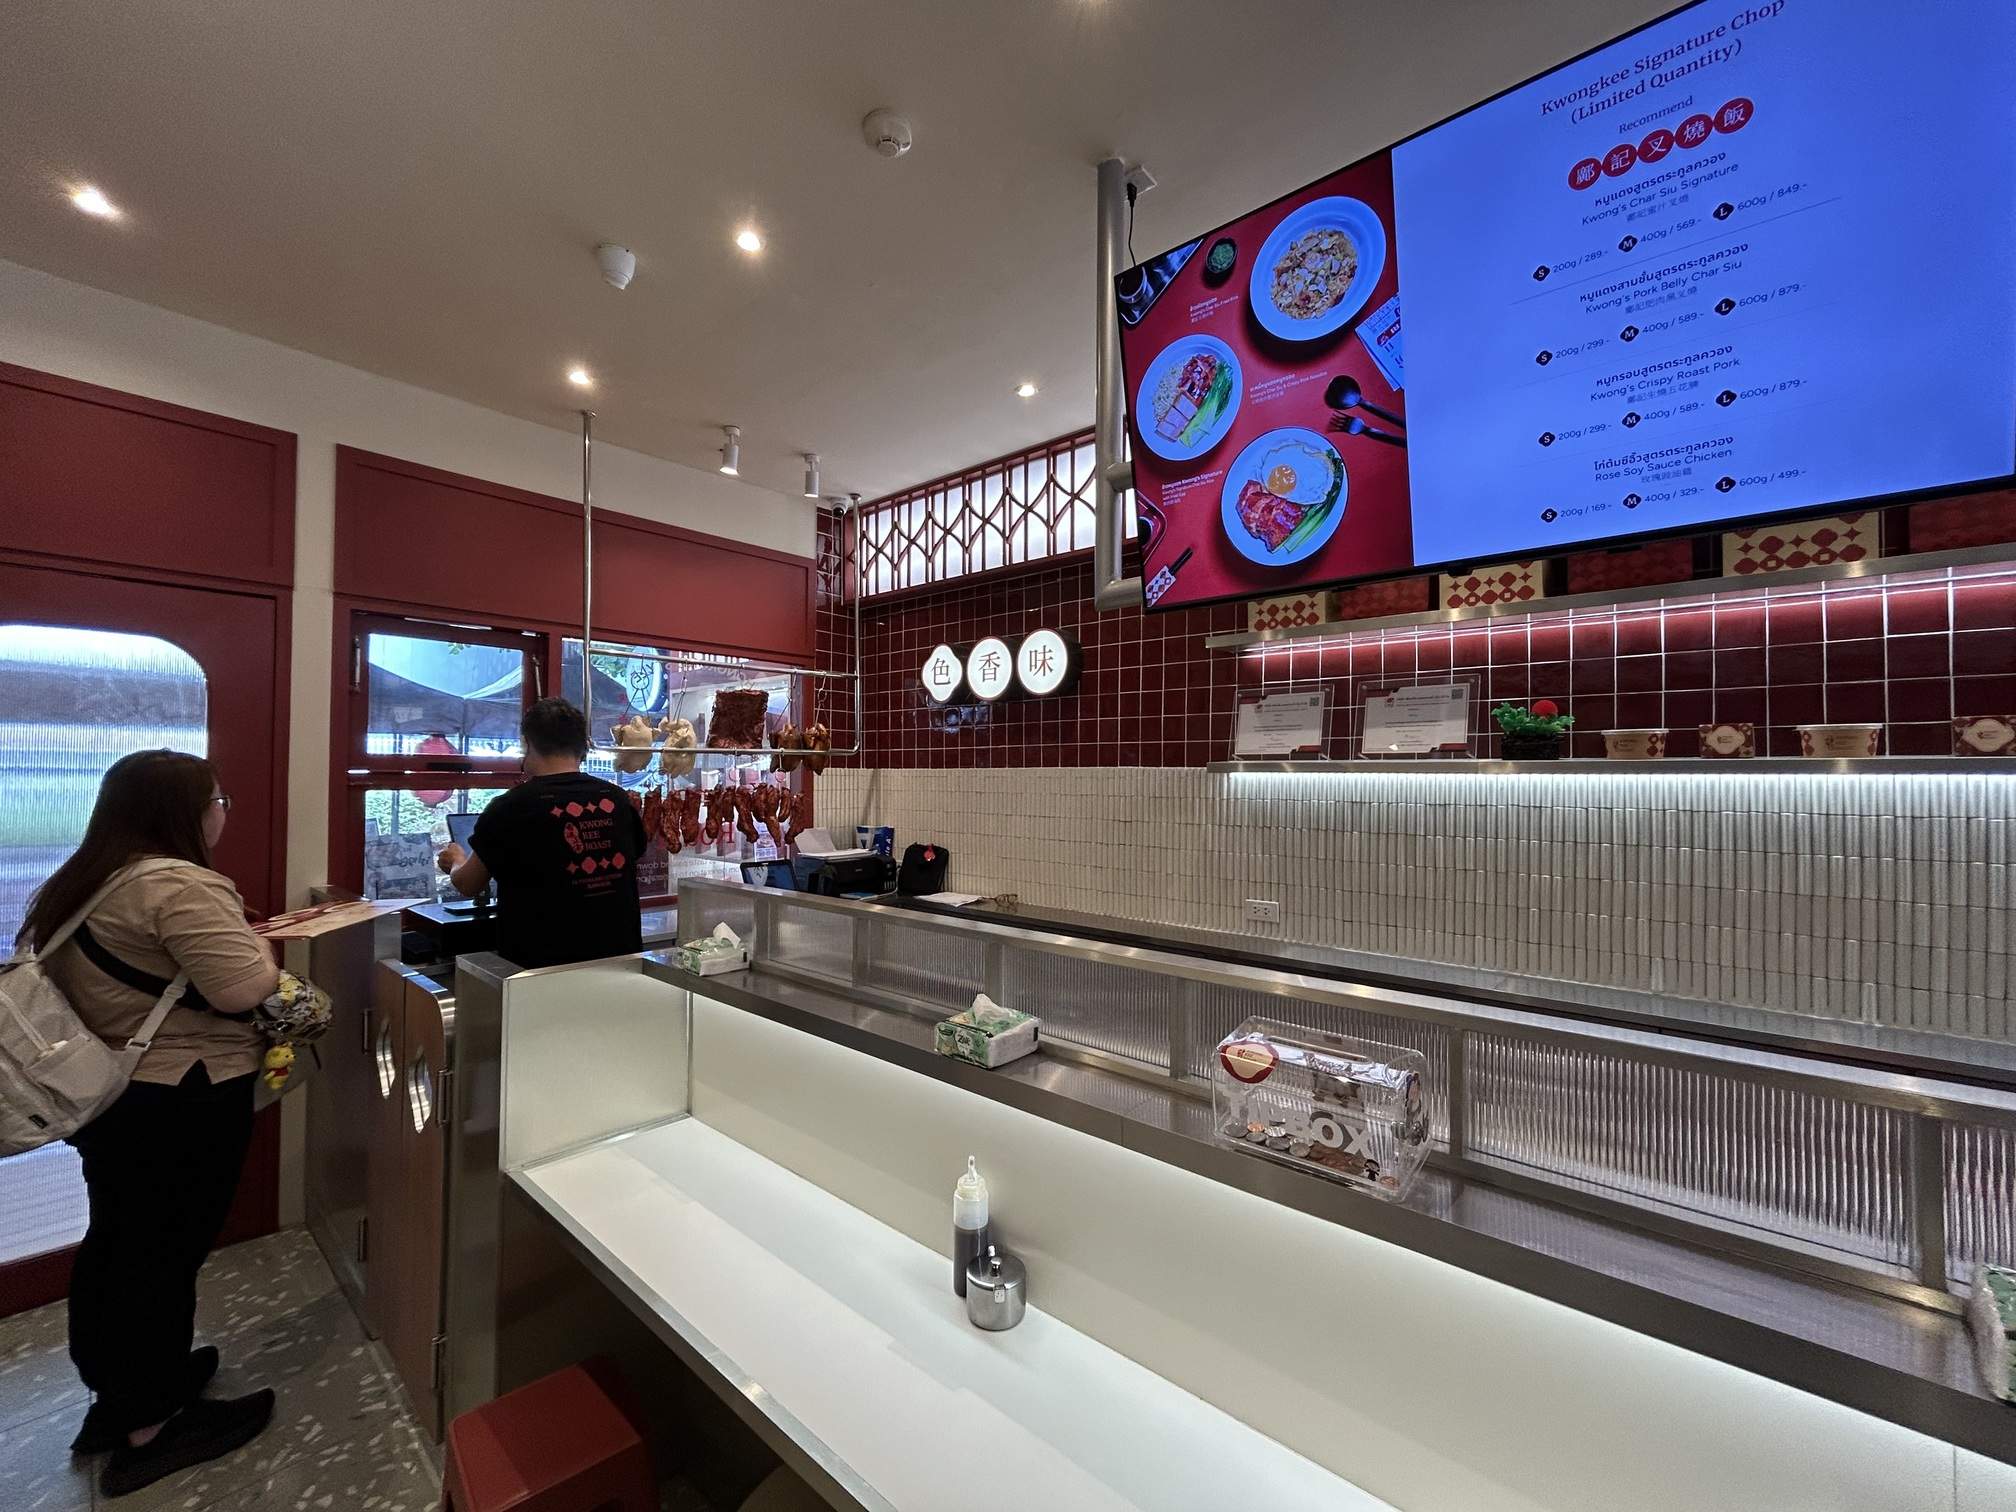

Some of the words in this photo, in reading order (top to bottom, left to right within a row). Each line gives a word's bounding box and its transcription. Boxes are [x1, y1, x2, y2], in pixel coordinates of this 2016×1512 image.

[1540, 67, 1630, 116] Kwongkee
[1634, 27, 1726, 74] Signature
[1731, 0, 1786, 31] Chop
[1571, 79, 1646, 125] (Limited
[1650, 38, 1742, 89] Quantity)
[1618, 96, 1694, 135] Recommend
[1582, 204, 1628, 226] Kwong's
[1629, 191, 1657, 209] Char
[1659, 184, 1678, 199] Siu
[1680, 163, 1739, 190] Signature
[1553, 259, 1577, 273] 200g
[1640, 229, 1667, 243] 400g
[1737, 195, 1767, 212] 600g
[1585, 294, 1631, 315] Kwong's
[1633, 284, 1659, 303] Pork
[1660, 276, 1688, 292] Belly
[1691, 267, 1719, 282] Char
[1722, 260, 1743, 273] Siu
[1555, 346, 1579, 359] 200g
[1642, 320, 1669, 334] 400g
[1738, 292, 1769, 308] 600g
[1590, 382, 1636, 402] Kwong's
[1637, 374, 1674, 391] Crispy
[1677, 366, 1710, 382] Roast
[1713, 357, 1740, 371] Pork
[1558, 428, 1582, 442] 200g
[1643, 409, 1671, 422] 400g
[1739, 387, 1769, 401] 600g
[1595, 468, 1621, 482] Rose
[1623, 464, 1645, 478] Soy
[1647, 459, 1682, 474] Sauce
[1684, 449, 1733, 465] Chicken
[1560, 507, 1584, 519] 200g
[1645, 491, 1671, 504] 400g
[1739, 474, 1769, 487] 600g
[932, 645, 1054, 686] 色香味
[580, 817, 614, 830] KWONG
[582, 831, 600, 840] KEE
